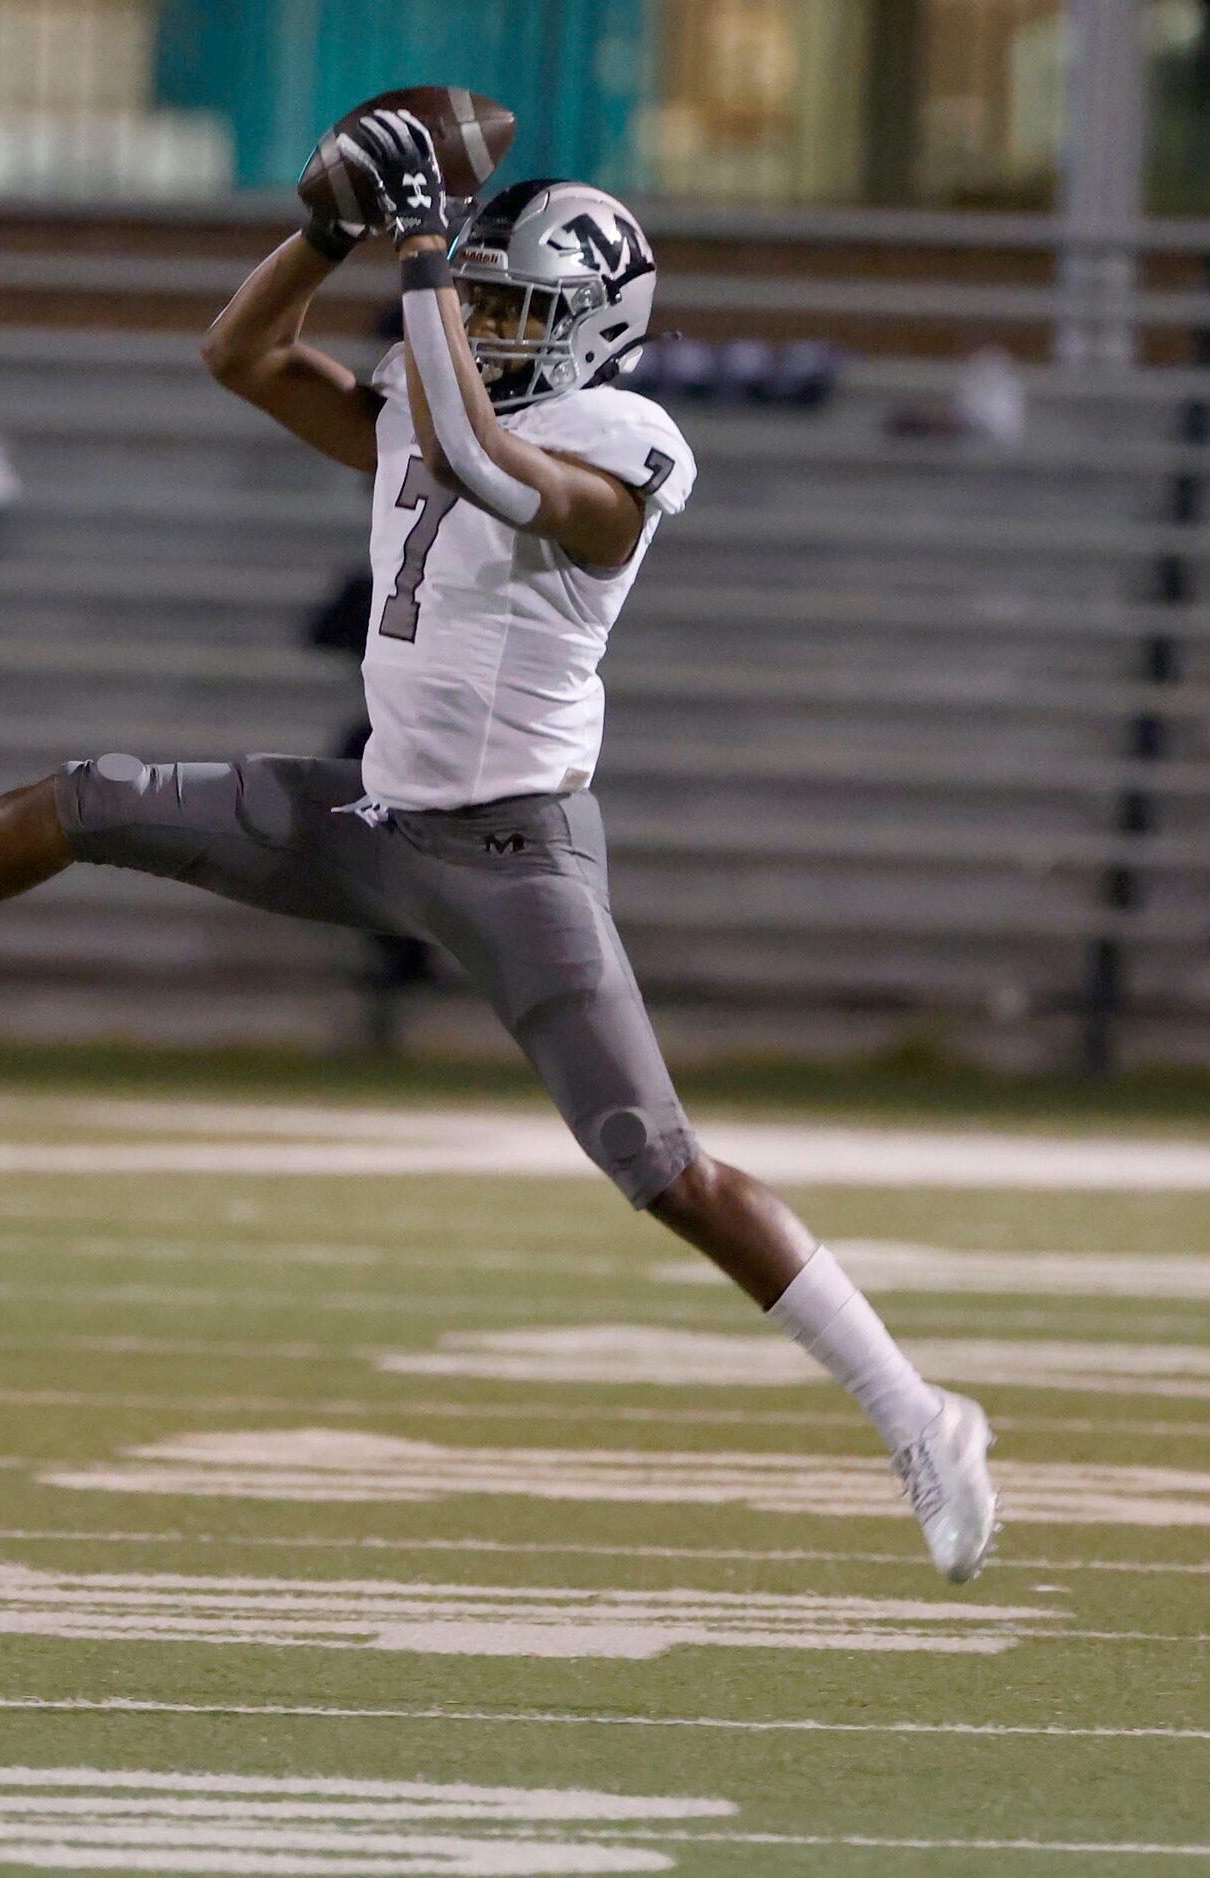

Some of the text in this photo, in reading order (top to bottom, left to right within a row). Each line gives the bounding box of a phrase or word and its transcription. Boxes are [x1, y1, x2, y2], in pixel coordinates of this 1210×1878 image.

[561, 212, 655, 275] M
[644, 446, 675, 496] 7
[379, 454, 459, 643] 7
